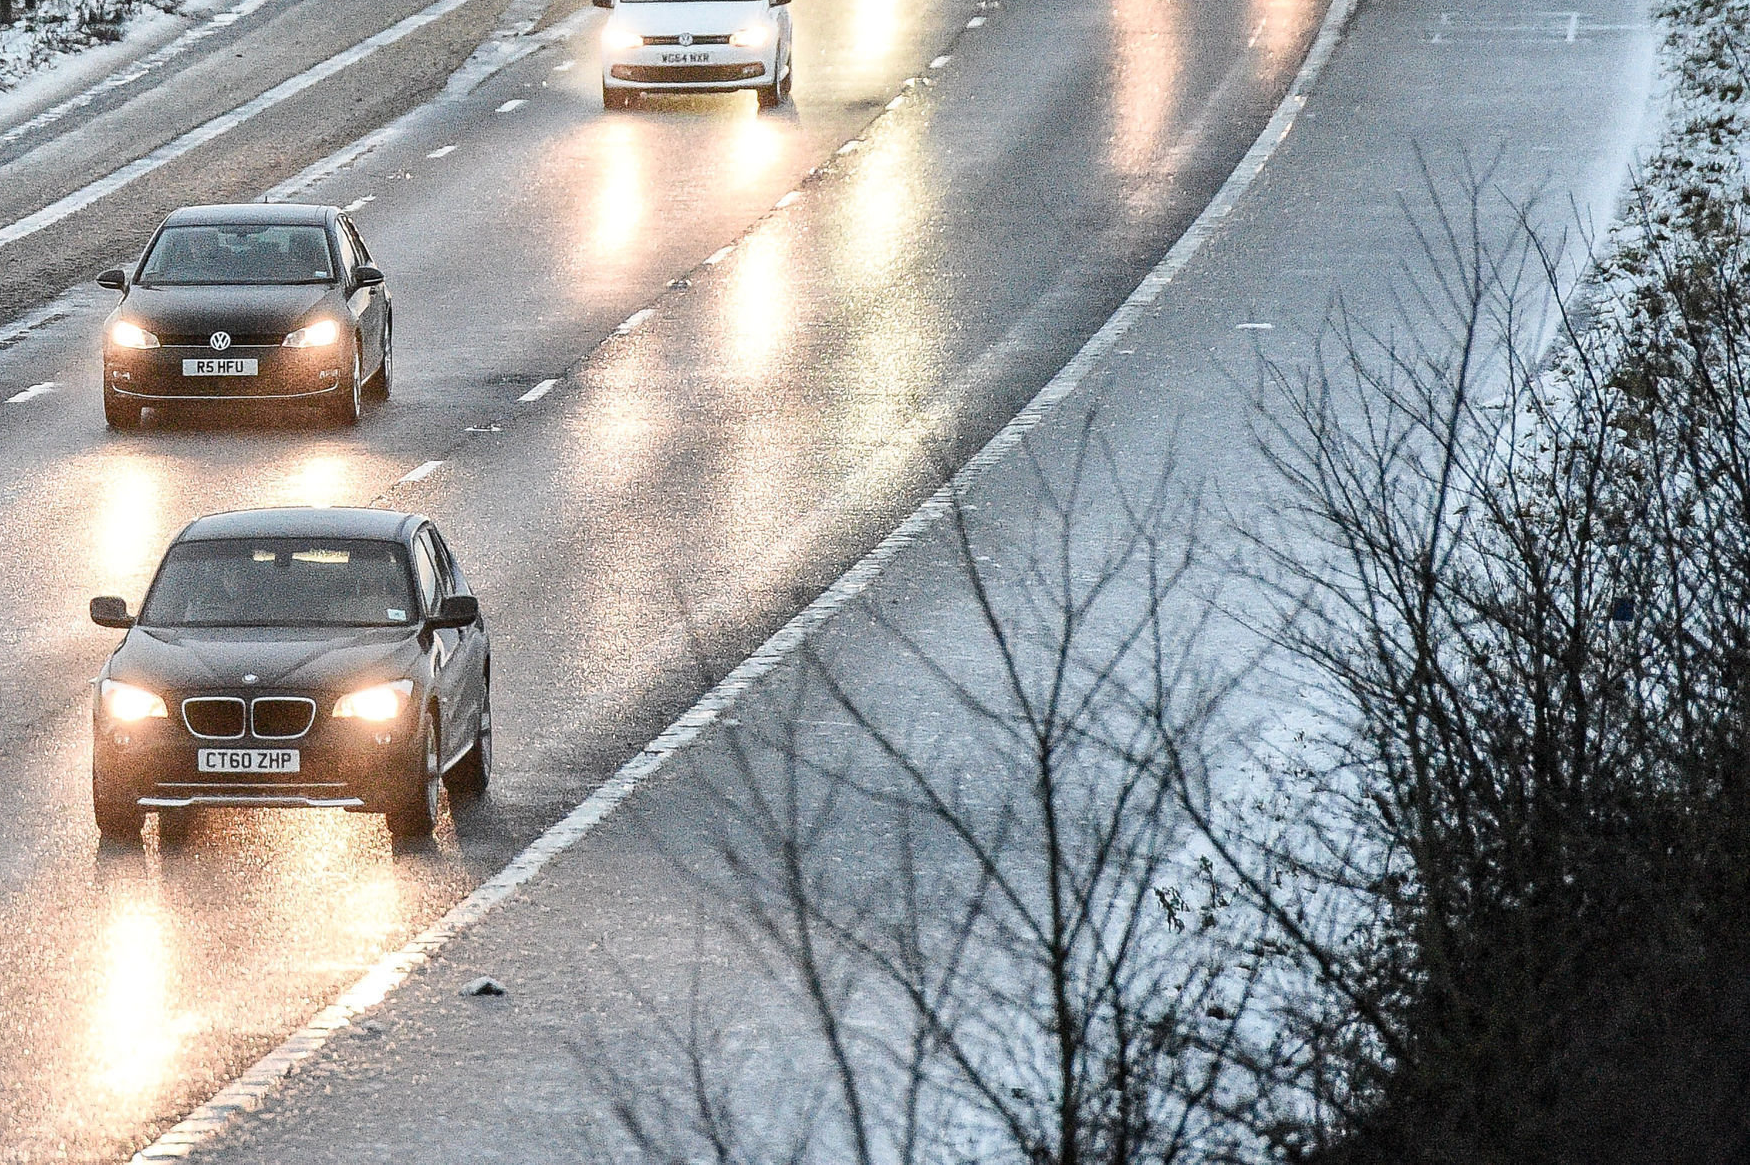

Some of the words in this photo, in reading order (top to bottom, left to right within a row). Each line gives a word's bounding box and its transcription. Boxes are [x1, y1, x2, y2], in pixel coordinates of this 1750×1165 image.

[197, 360, 214, 373] R5
[217, 360, 244, 373] HFU
[206, 751, 252, 769] CT60
[257, 751, 292, 769] ZHP
